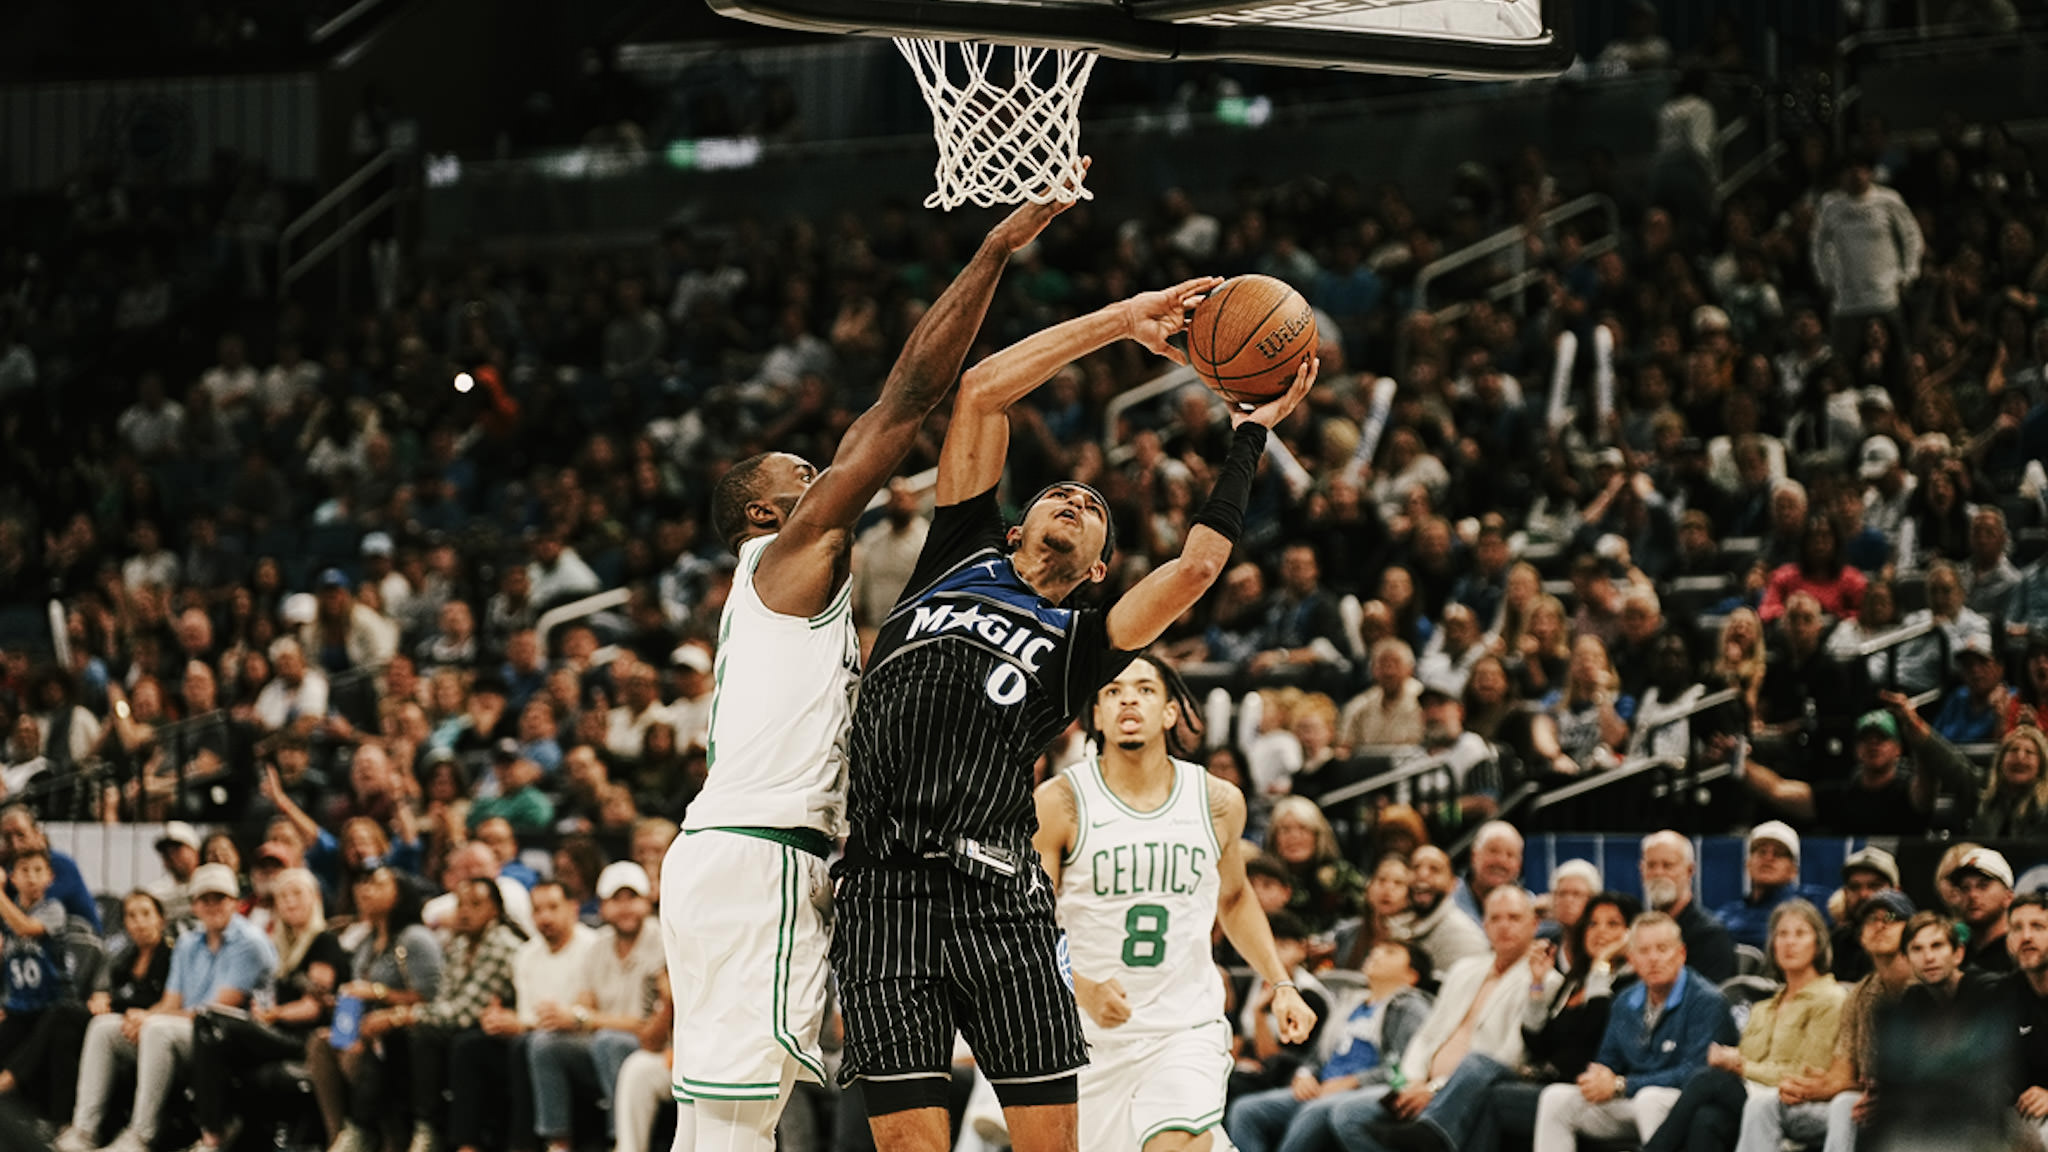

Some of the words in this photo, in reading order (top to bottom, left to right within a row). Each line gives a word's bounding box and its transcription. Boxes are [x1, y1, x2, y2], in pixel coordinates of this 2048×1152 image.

[905, 602, 1056, 673] MAGIC
[986, 662, 1027, 706] 0
[1092, 842, 1206, 897] CELTICS
[1121, 903, 1170, 968] 8
